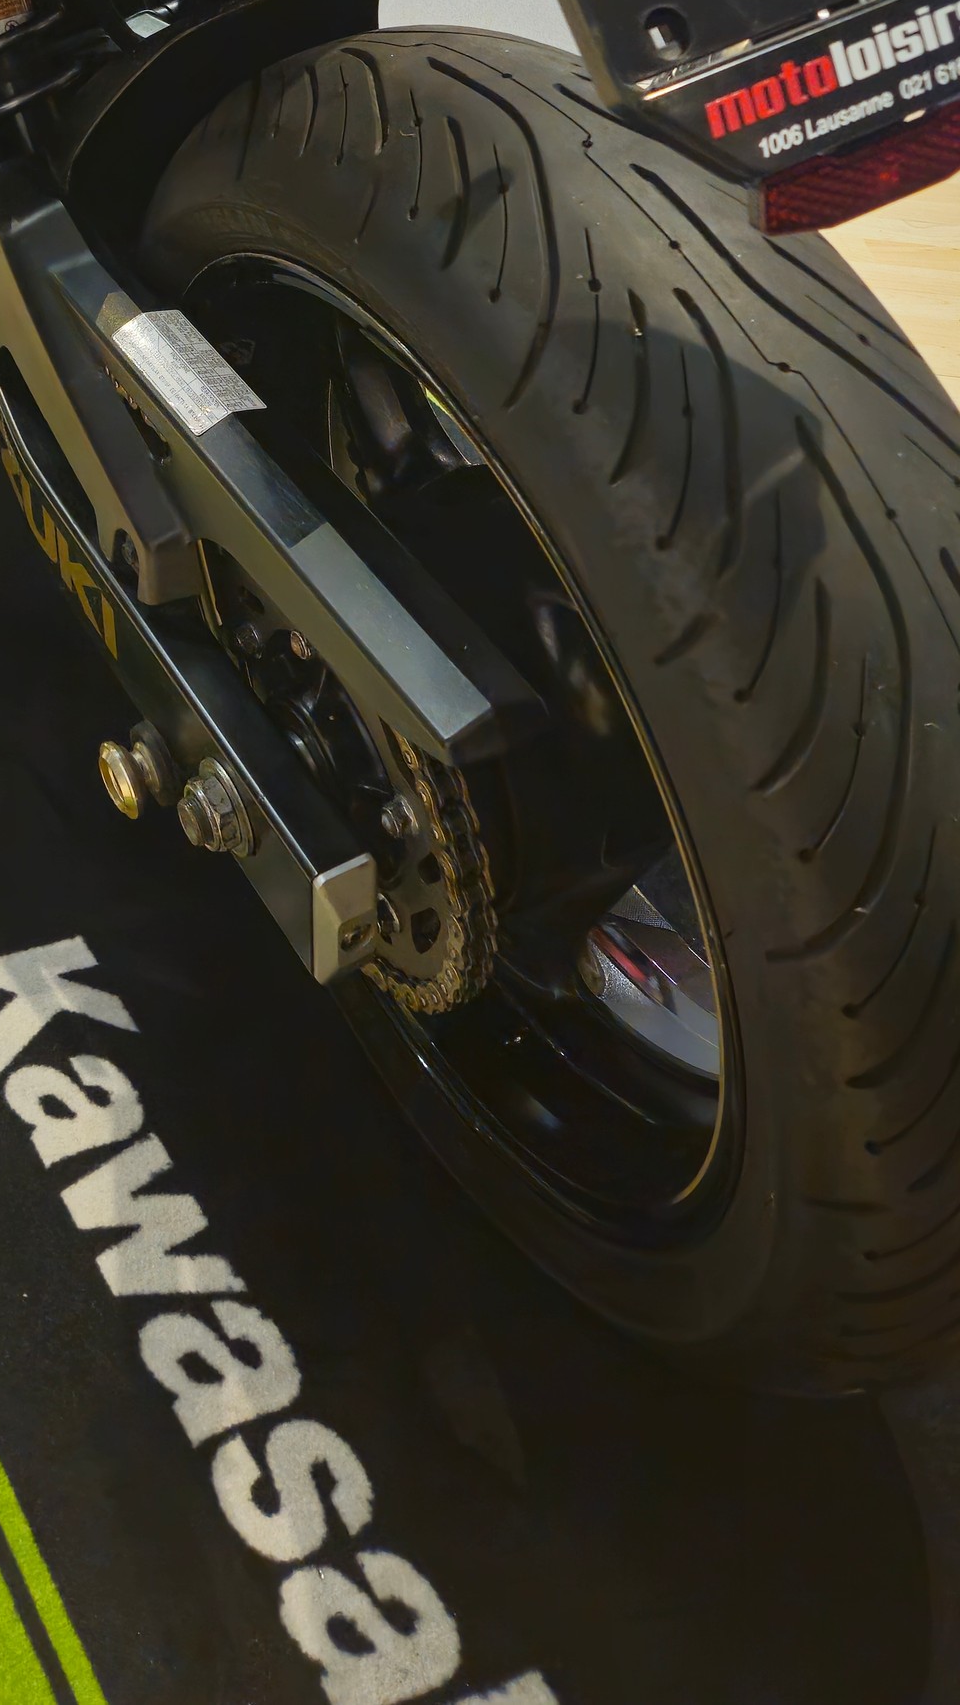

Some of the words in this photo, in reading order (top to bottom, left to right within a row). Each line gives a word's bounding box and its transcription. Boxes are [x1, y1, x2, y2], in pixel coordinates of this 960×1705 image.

[704, 0, 960, 139] motoloisir
[758, 124, 804, 159] 1006
[804, 90, 895, 140] Lausanne
[899, 70, 933, 100] 021
